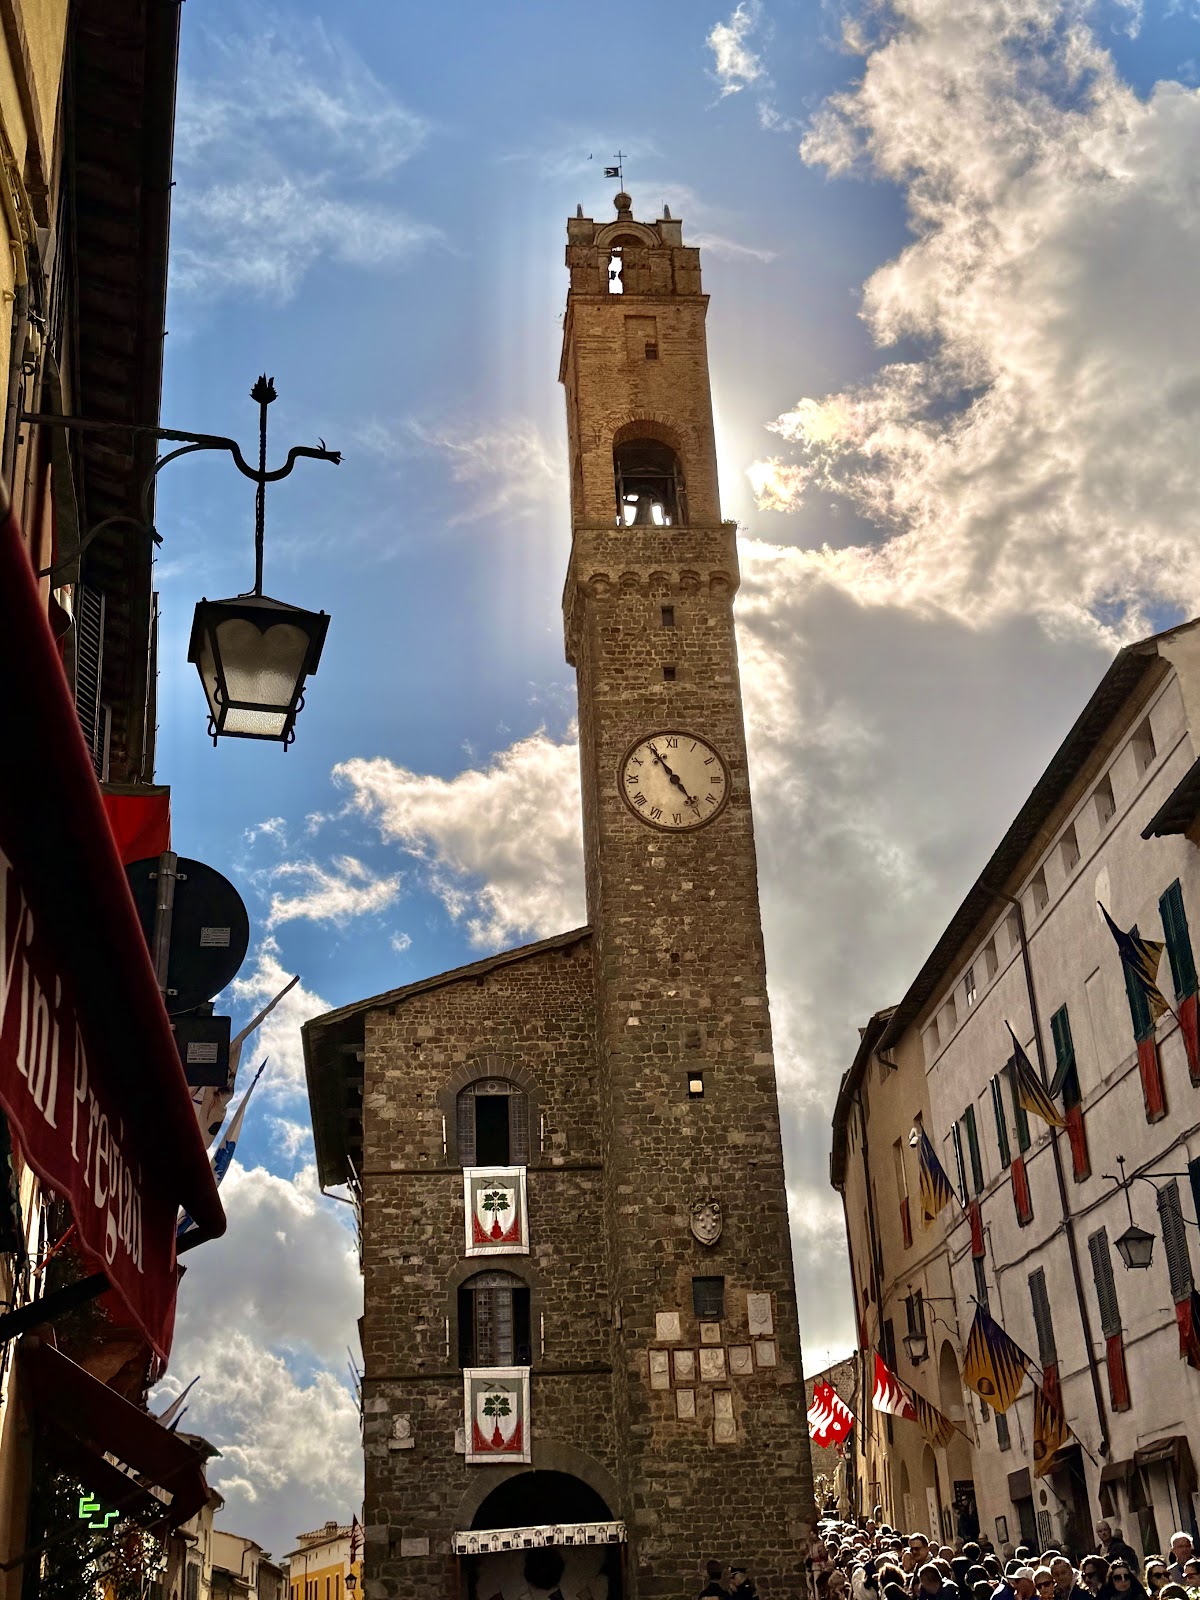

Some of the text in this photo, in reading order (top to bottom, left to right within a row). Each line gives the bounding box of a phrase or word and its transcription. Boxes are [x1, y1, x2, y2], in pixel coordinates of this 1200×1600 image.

[666, 739, 678, 748] XII
[690, 742, 697, 752] I
[632, 757, 644, 766] X
[704, 757, 716, 765] II
[627, 774, 639, 784] IX
[672, 814, 682, 823] VI
